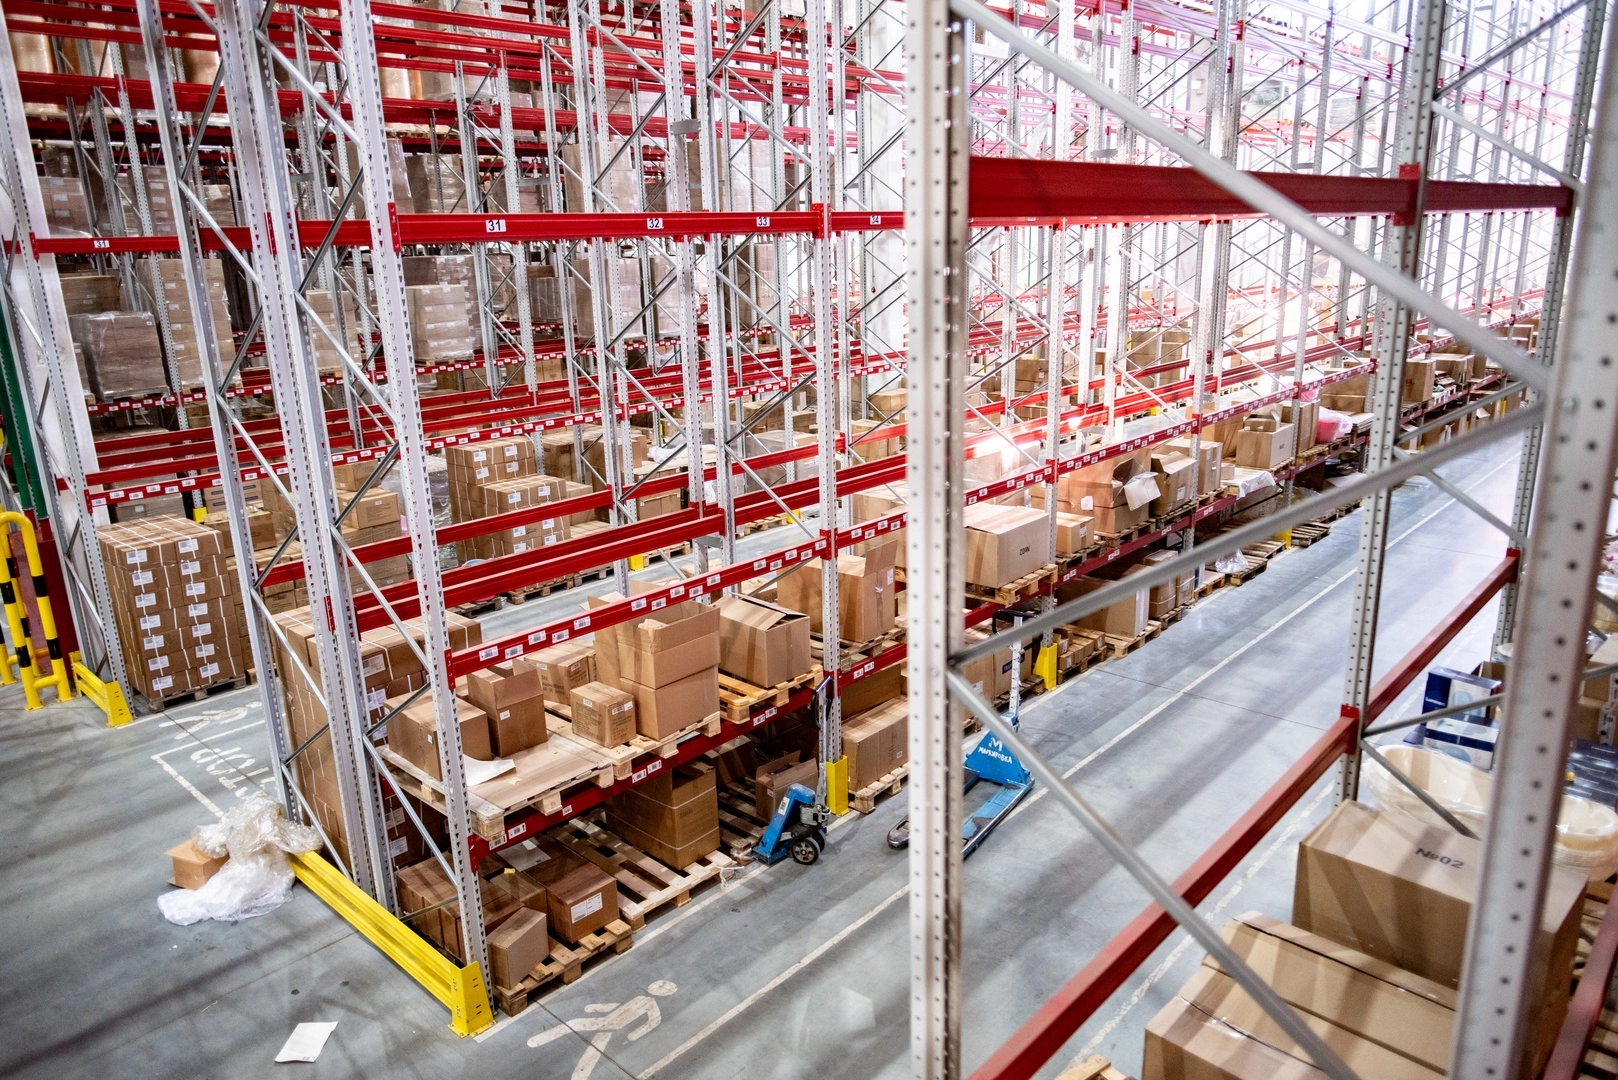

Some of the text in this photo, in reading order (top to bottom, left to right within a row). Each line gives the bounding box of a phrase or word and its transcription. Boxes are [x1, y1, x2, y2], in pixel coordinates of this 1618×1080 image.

[488, 218, 502, 231] 31
[648, 218, 660, 228] 32
[757, 216, 768, 226] 33
[871, 216, 879, 224] 34
